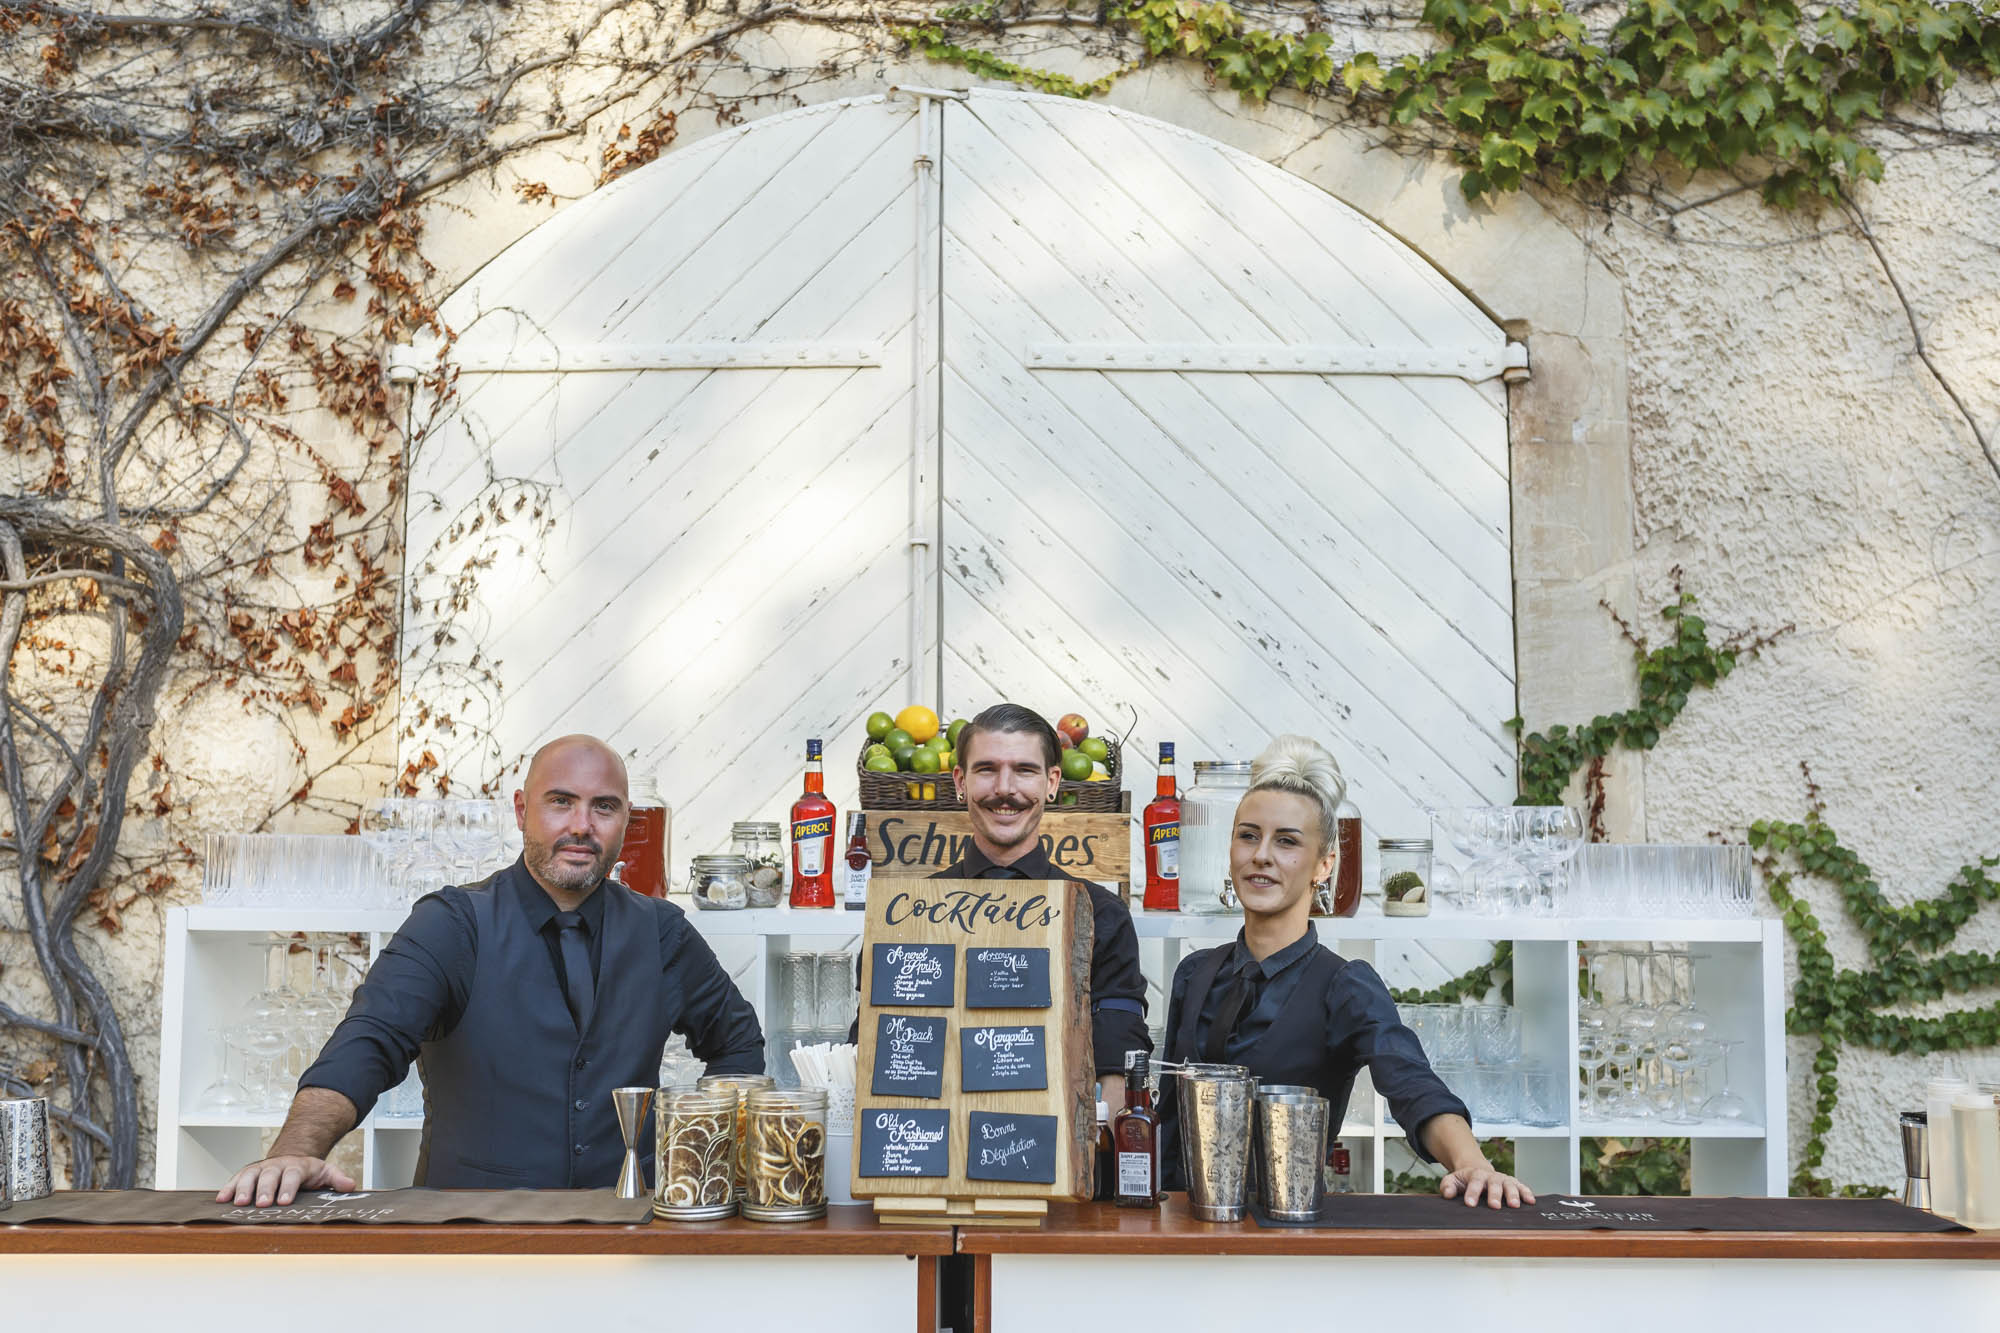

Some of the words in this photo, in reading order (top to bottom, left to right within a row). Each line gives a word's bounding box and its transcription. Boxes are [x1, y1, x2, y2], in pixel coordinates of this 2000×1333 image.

[794, 821, 829, 839] APEROL
[1152, 826, 1181, 842] APER
[873, 817, 1099, 867] Schwes
[886, 945, 929, 966] Aperol
[977, 949, 1012, 963] Moscow
[1003, 954, 1029, 973] Mule
[900, 957, 943, 980] Spritz
[992, 982, 1010, 991] Ginger
[901, 1025, 934, 1043] Peach
[974, 1027, 1035, 1052] Margarita
[889, 1039, 915, 1053] Tea
[875, 1112, 900, 1131] Old
[889, 1119, 945, 1143] Fashioned
[981, 1122, 1017, 1140] Bonne
[980, 1137, 1037, 1167] Dégustation
